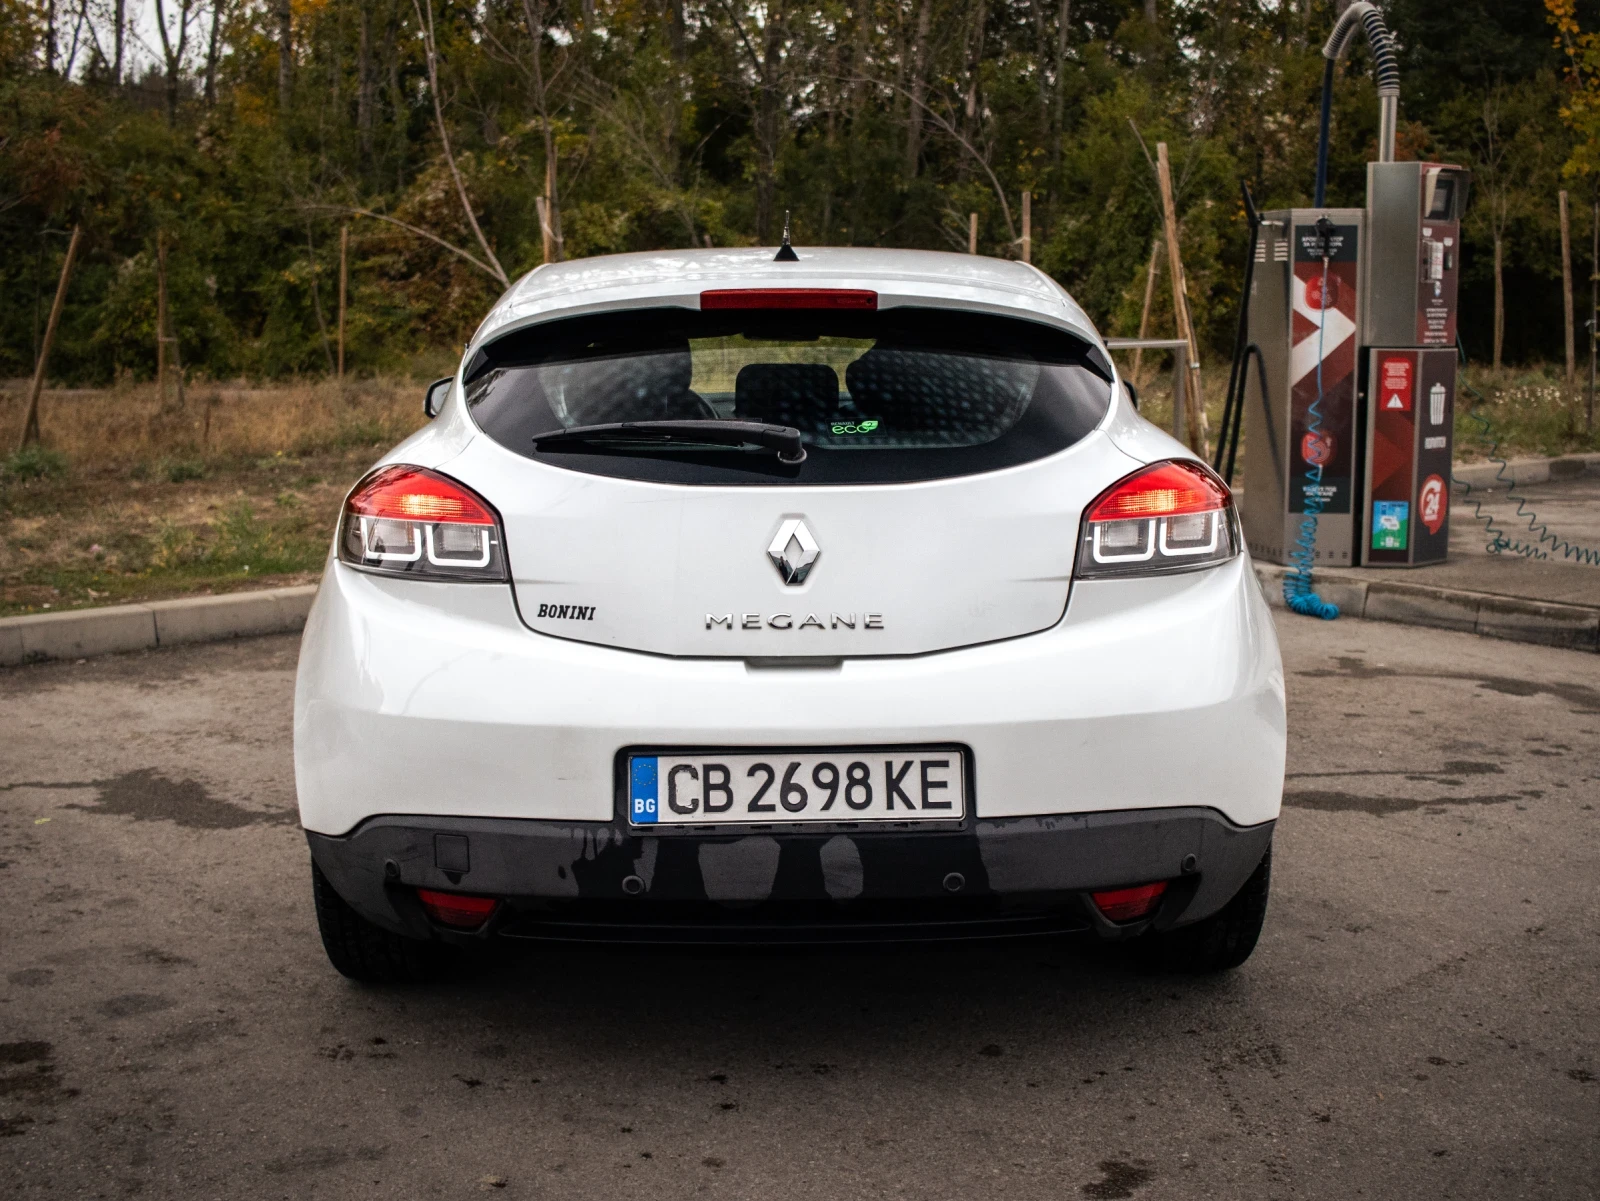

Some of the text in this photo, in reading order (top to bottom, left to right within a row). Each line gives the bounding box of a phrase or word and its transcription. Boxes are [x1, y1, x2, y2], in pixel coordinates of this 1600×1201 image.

[1425, 493, 1440, 516] 24
[537, 603, 596, 620] BONINI
[705, 612, 885, 630] MEGANE
[668, 760, 952, 814] CB 2698 KE
[634, 798, 656, 813] BG
